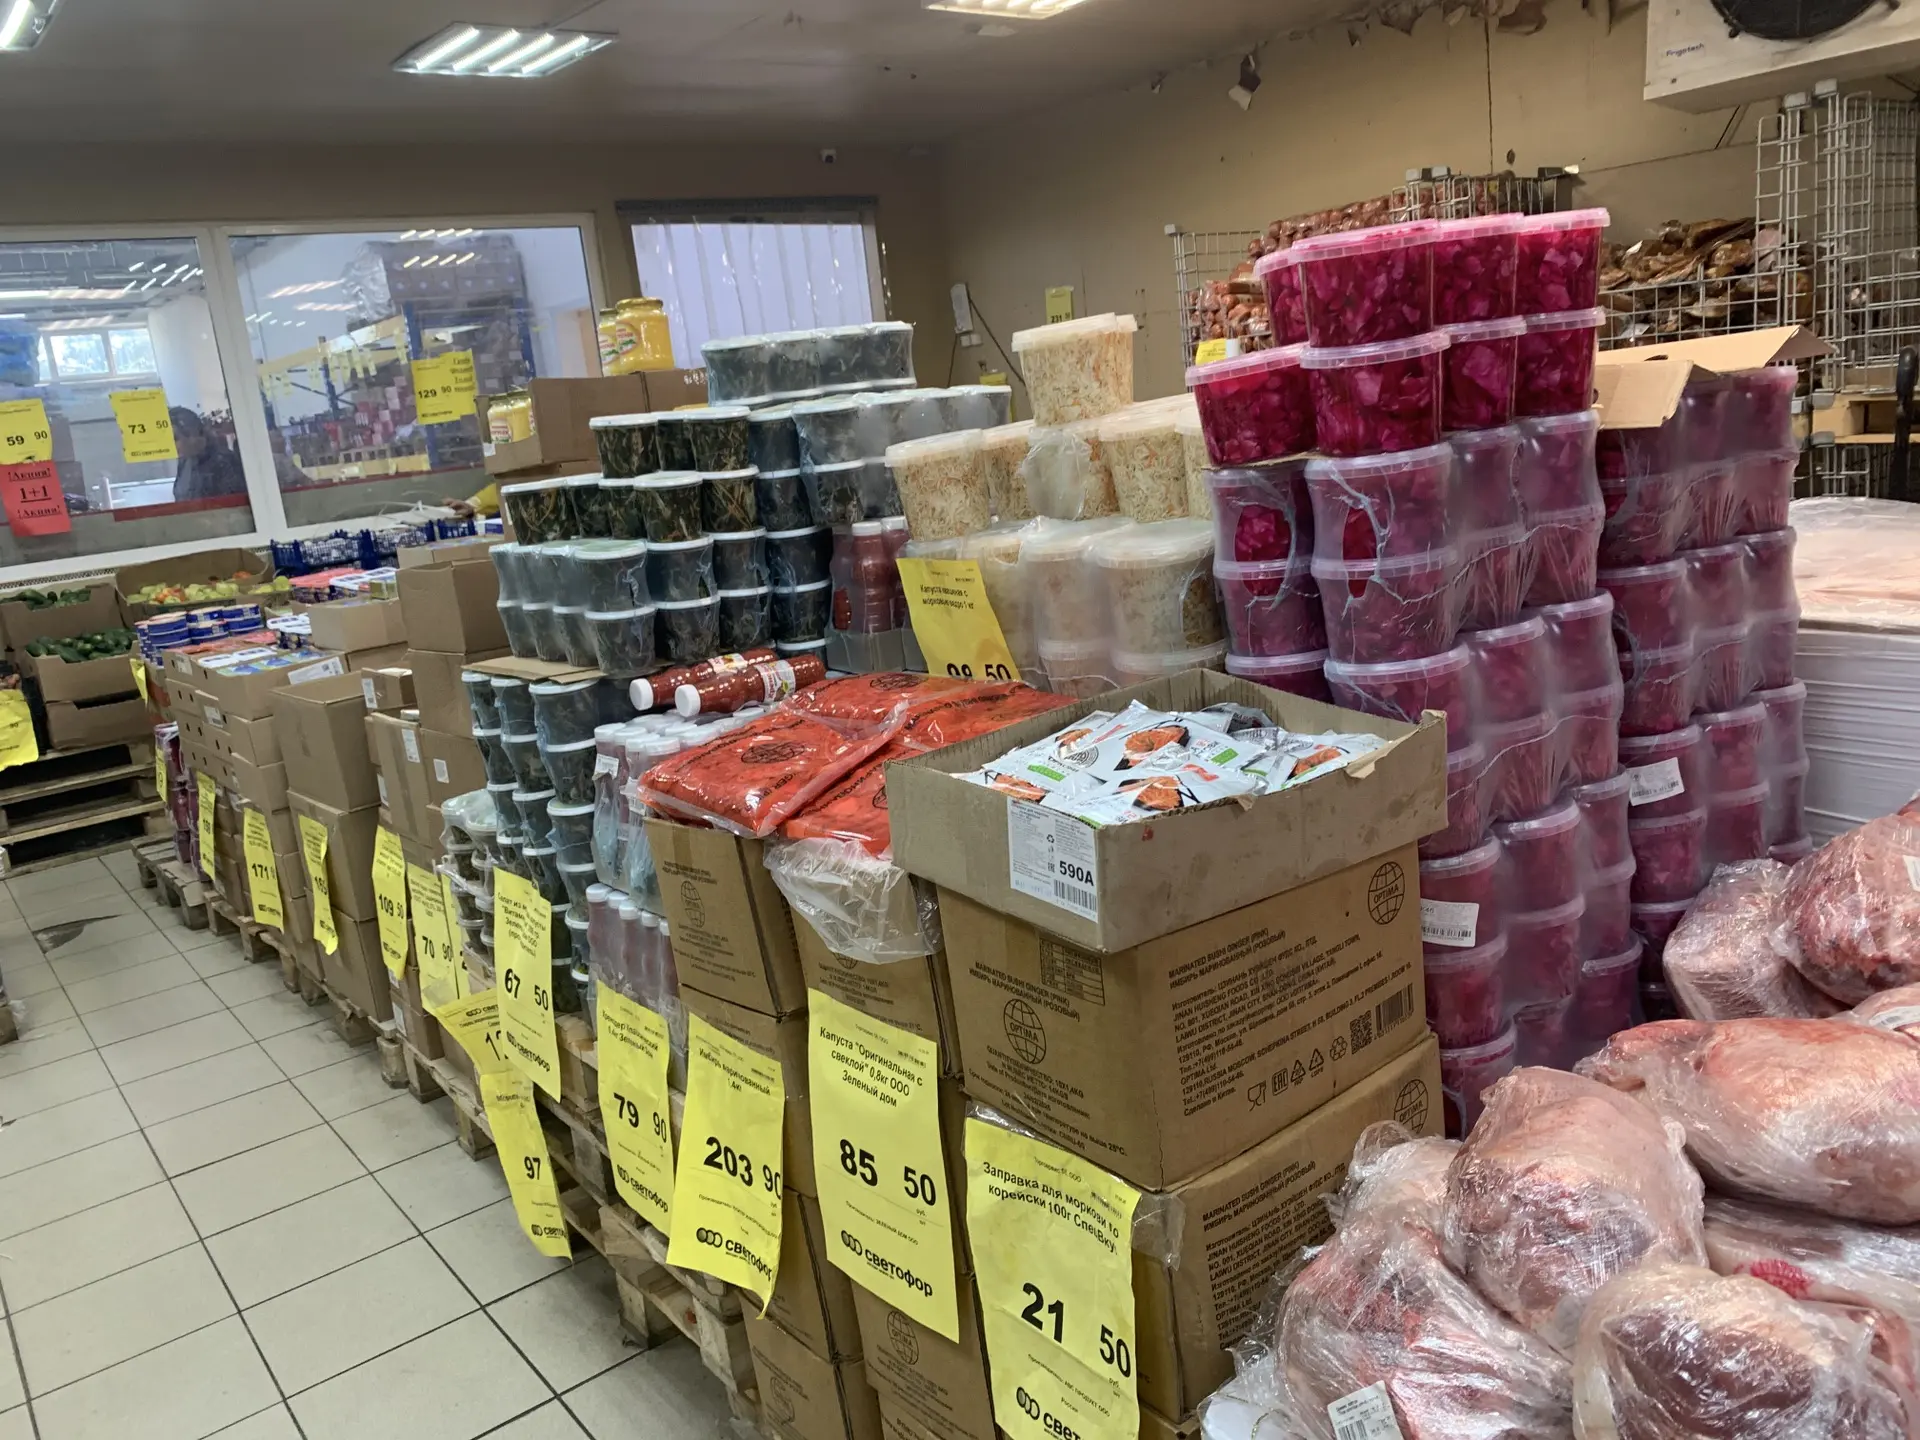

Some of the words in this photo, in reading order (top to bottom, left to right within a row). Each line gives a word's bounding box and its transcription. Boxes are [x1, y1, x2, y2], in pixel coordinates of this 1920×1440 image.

[418, 389, 437, 399] 129
[6, 435, 25, 446] 59
[34, 430, 48, 440] 90
[128, 423, 147, 435] 73
[156, 420, 169, 429] 50
[20, 485, 48, 500] 1+1
[251, 863, 270, 881] 171
[1059, 860, 1094, 886] 590A
[379, 893, 394, 917] 109
[1373, 883, 1399, 904] OPTIMA
[422, 935, 435, 959] 70
[441, 943, 453, 962] 90
[1168, 956, 1207, 979] MARINATED
[1207, 947, 1227, 962] SUSHI
[1227, 935, 1250, 953] GINGER
[1170, 971, 1198, 990] ИМБИРЬ
[1198, 946, 1252, 977] МАРИНОВАННЫЙ
[1252, 930, 1286, 954] (РОЗОВЫЙ)
[504, 967, 521, 999] 67
[534, 985, 549, 1011] 50
[969, 967, 992, 985] ИМБИРЬ
[992, 977, 1043, 1006] МАРИНОВАННЫЙ
[1043, 1000, 1080, 1023] (РОЗОВЫЙ)
[975, 961, 1007, 981] MARINATED
[1007, 974, 1025, 988] SUSHI
[1025, 982, 1050, 998] GINGER
[1174, 1008, 1193, 1022] JINAN
[1227, 981, 1249, 998] FOODS
[1009, 1022, 1040, 1043] OPTIMA
[819, 1026, 853, 1050] Капуста
[855, 1041, 916, 1085] "Оригинальная
[917, 1076, 923, 1086] с
[831, 1049, 868, 1074] свеклой"
[869, 1065, 888, 1085] 0,8кг
[889, 1076, 910, 1097] ООО
[842, 1069, 878, 1098] Зеленый
[879, 1091, 897, 1108] дом
[1180, 1067, 1206, 1085] OPTIMA
[613, 1092, 639, 1128] 79
[653, 1111, 667, 1143] 90
[1399, 1099, 1424, 1122] OPTIMA
[703, 1136, 754, 1187] 203
[762, 1164, 782, 1200] 90
[1107, 1142, 1128, 1157] 25°C.
[524, 1156, 541, 1181] 97
[840, 1138, 878, 1187] 85
[904, 1165, 937, 1206] 50
[630, 1177, 669, 1213] светофор
[983, 1161, 1039, 1187] Заправка
[1042, 1183, 1063, 1200] для
[1065, 1193, 1107, 1229] моркови
[988, 1184, 1046, 1208] корейски
[1048, 1202, 1072, 1220] 100г
[1202, 1196, 1241, 1222] MARINATED
[1241, 1185, 1260, 1202] SUSHI
[1260, 1172, 1282, 1191] GINGER
[1204, 1213, 1233, 1232] ИМБИРЬ
[1233, 1182, 1284, 1217] МАРИНОВАННЫЙ
[1284, 1160, 1316, 1188] (РОЗОВЫЙ)
[864, 1248, 933, 1298] светофор
[1021, 1282, 1064, 1344] 21
[1100, 1324, 1131, 1379] 50
